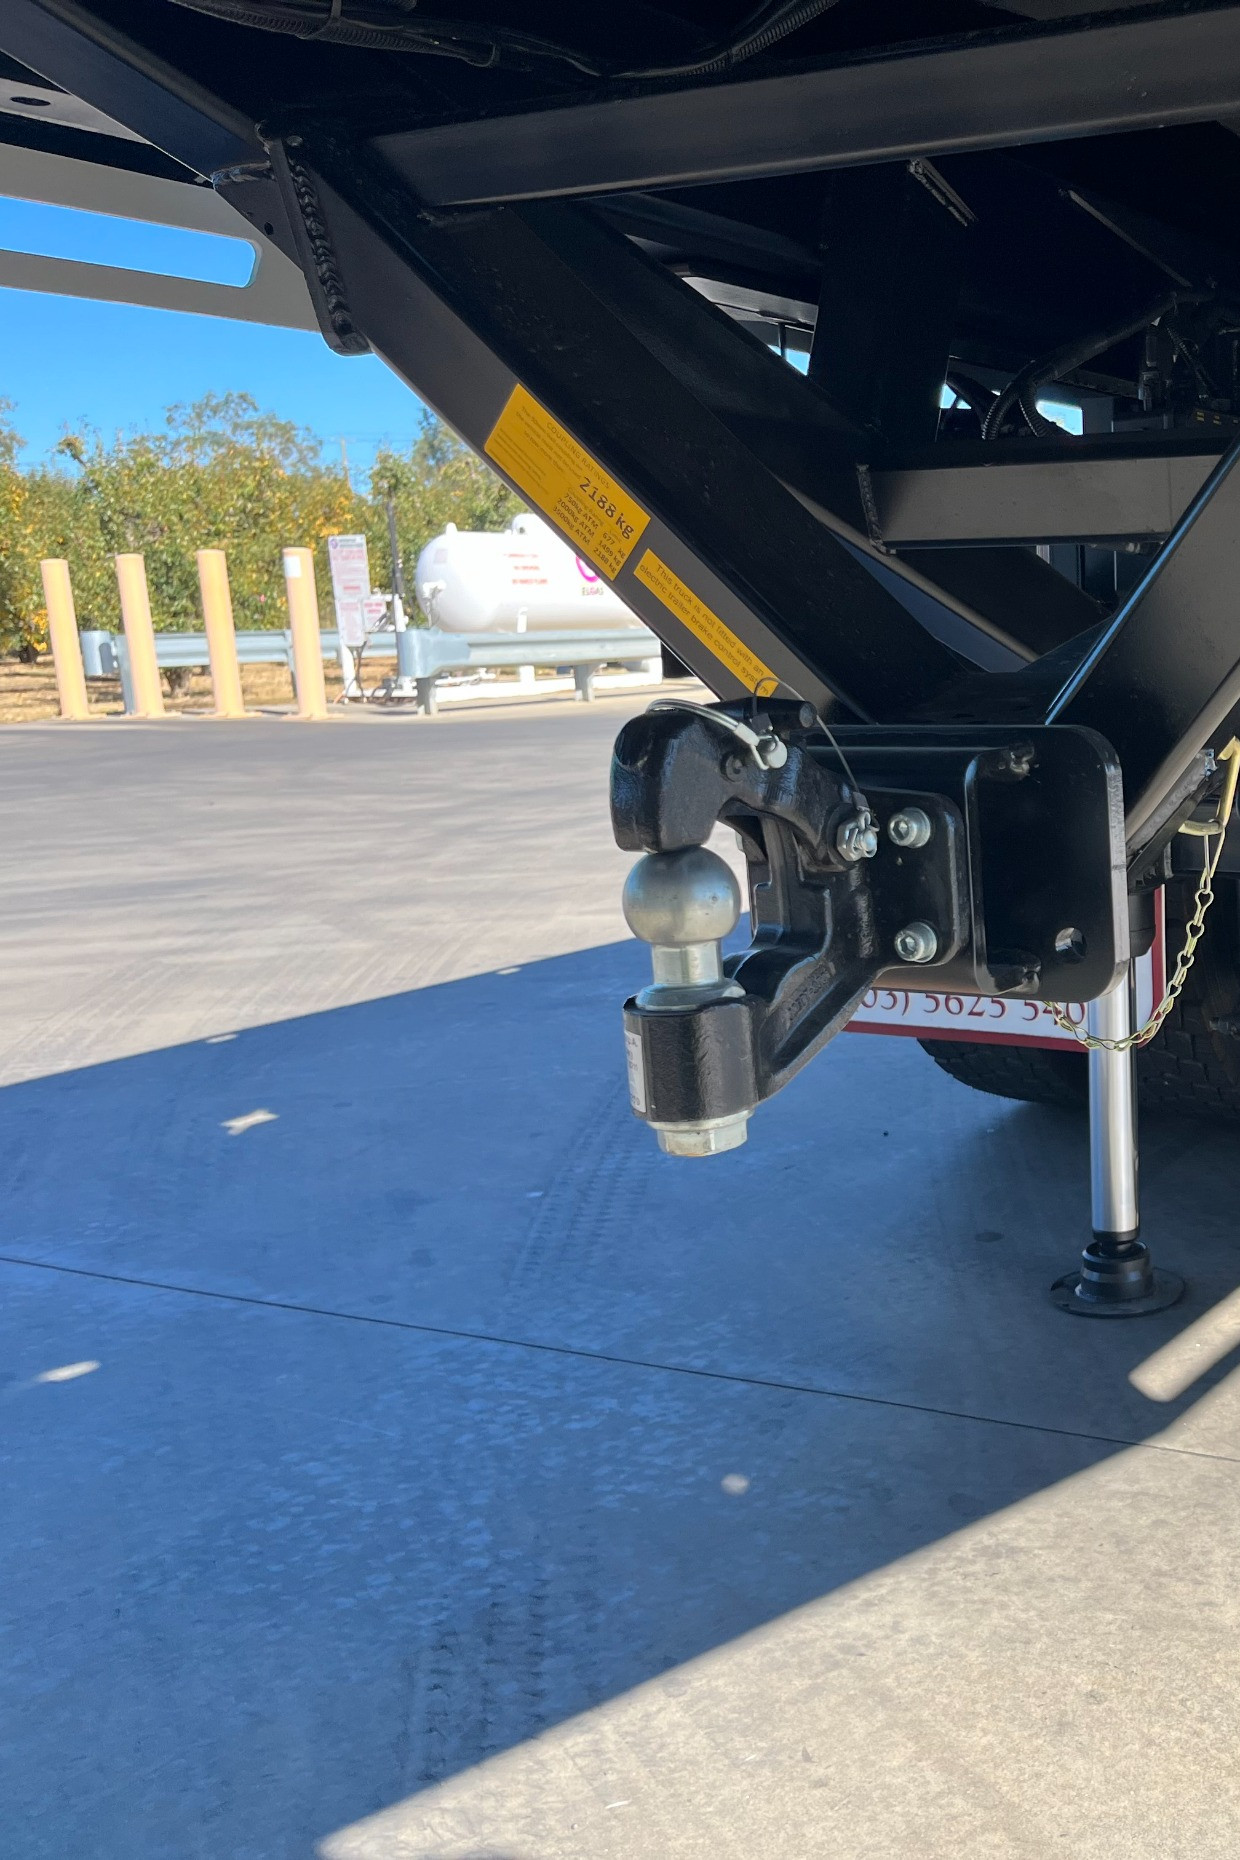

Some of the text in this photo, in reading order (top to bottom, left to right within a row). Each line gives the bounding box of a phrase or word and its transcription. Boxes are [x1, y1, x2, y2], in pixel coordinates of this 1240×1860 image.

[545, 420, 611, 489] COUPLING RATINGS
[551, 504, 575, 531] 3500kg
[574, 527, 590, 545] ATM
[607, 561, 617, 574] kg
[555, 497, 579, 524] 2000kg
[578, 519, 594, 538] ATM
[611, 554, 622, 567] kg
[563, 492, 626, 560] 750kg ATM 677 kg
[578, 475, 636, 541] 2188 kg
[638, 561, 769, 697] electric trailer brake control systm
[654, 563, 764, 677] This truck is not fitted with an
